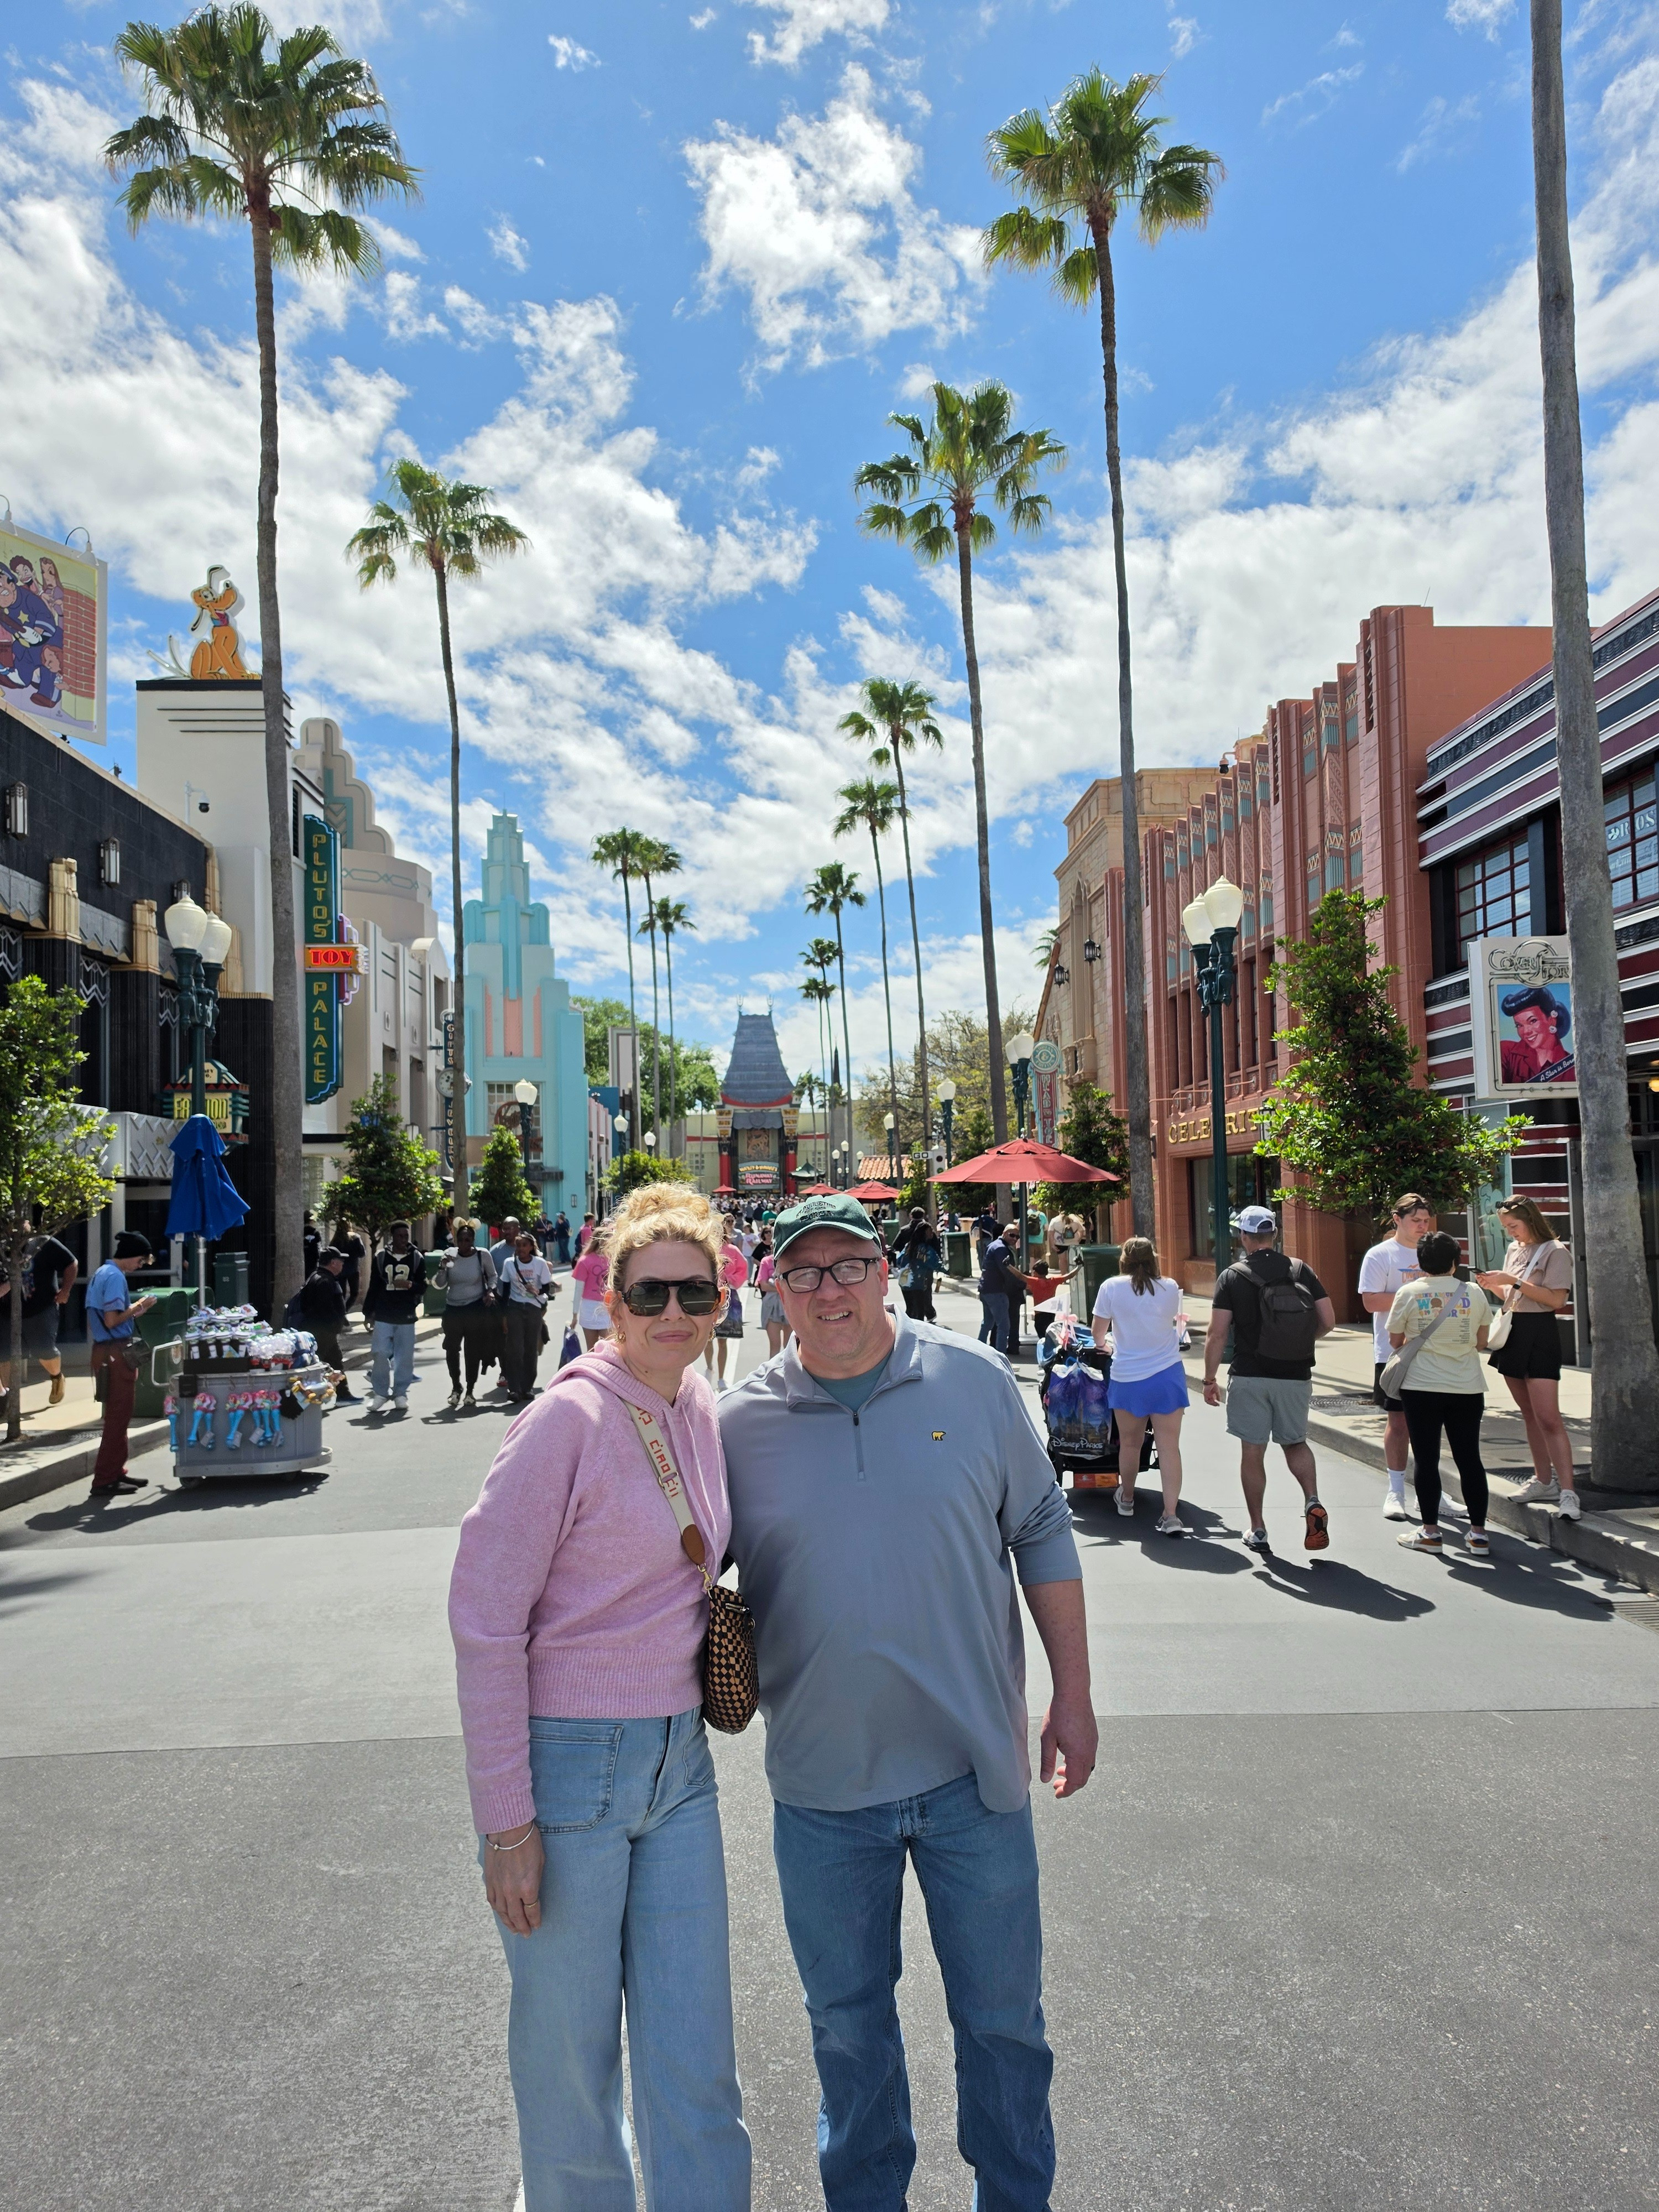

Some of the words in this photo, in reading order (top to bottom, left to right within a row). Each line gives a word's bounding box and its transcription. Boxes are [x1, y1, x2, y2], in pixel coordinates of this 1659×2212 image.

[312, 834, 332, 938] PLUTO'S
[309, 949, 354, 966] TOY
[1528, 949, 1570, 981] STOR
[312, 982, 328, 1083] PALACE
[1540, 1074, 1546, 1082] A
[1545, 1068, 1558, 1079] Star
[174, 1098, 228, 1120] FAION
[1168, 1107, 1264, 1144] CELERIT
[385, 1264, 410, 1291] 12
